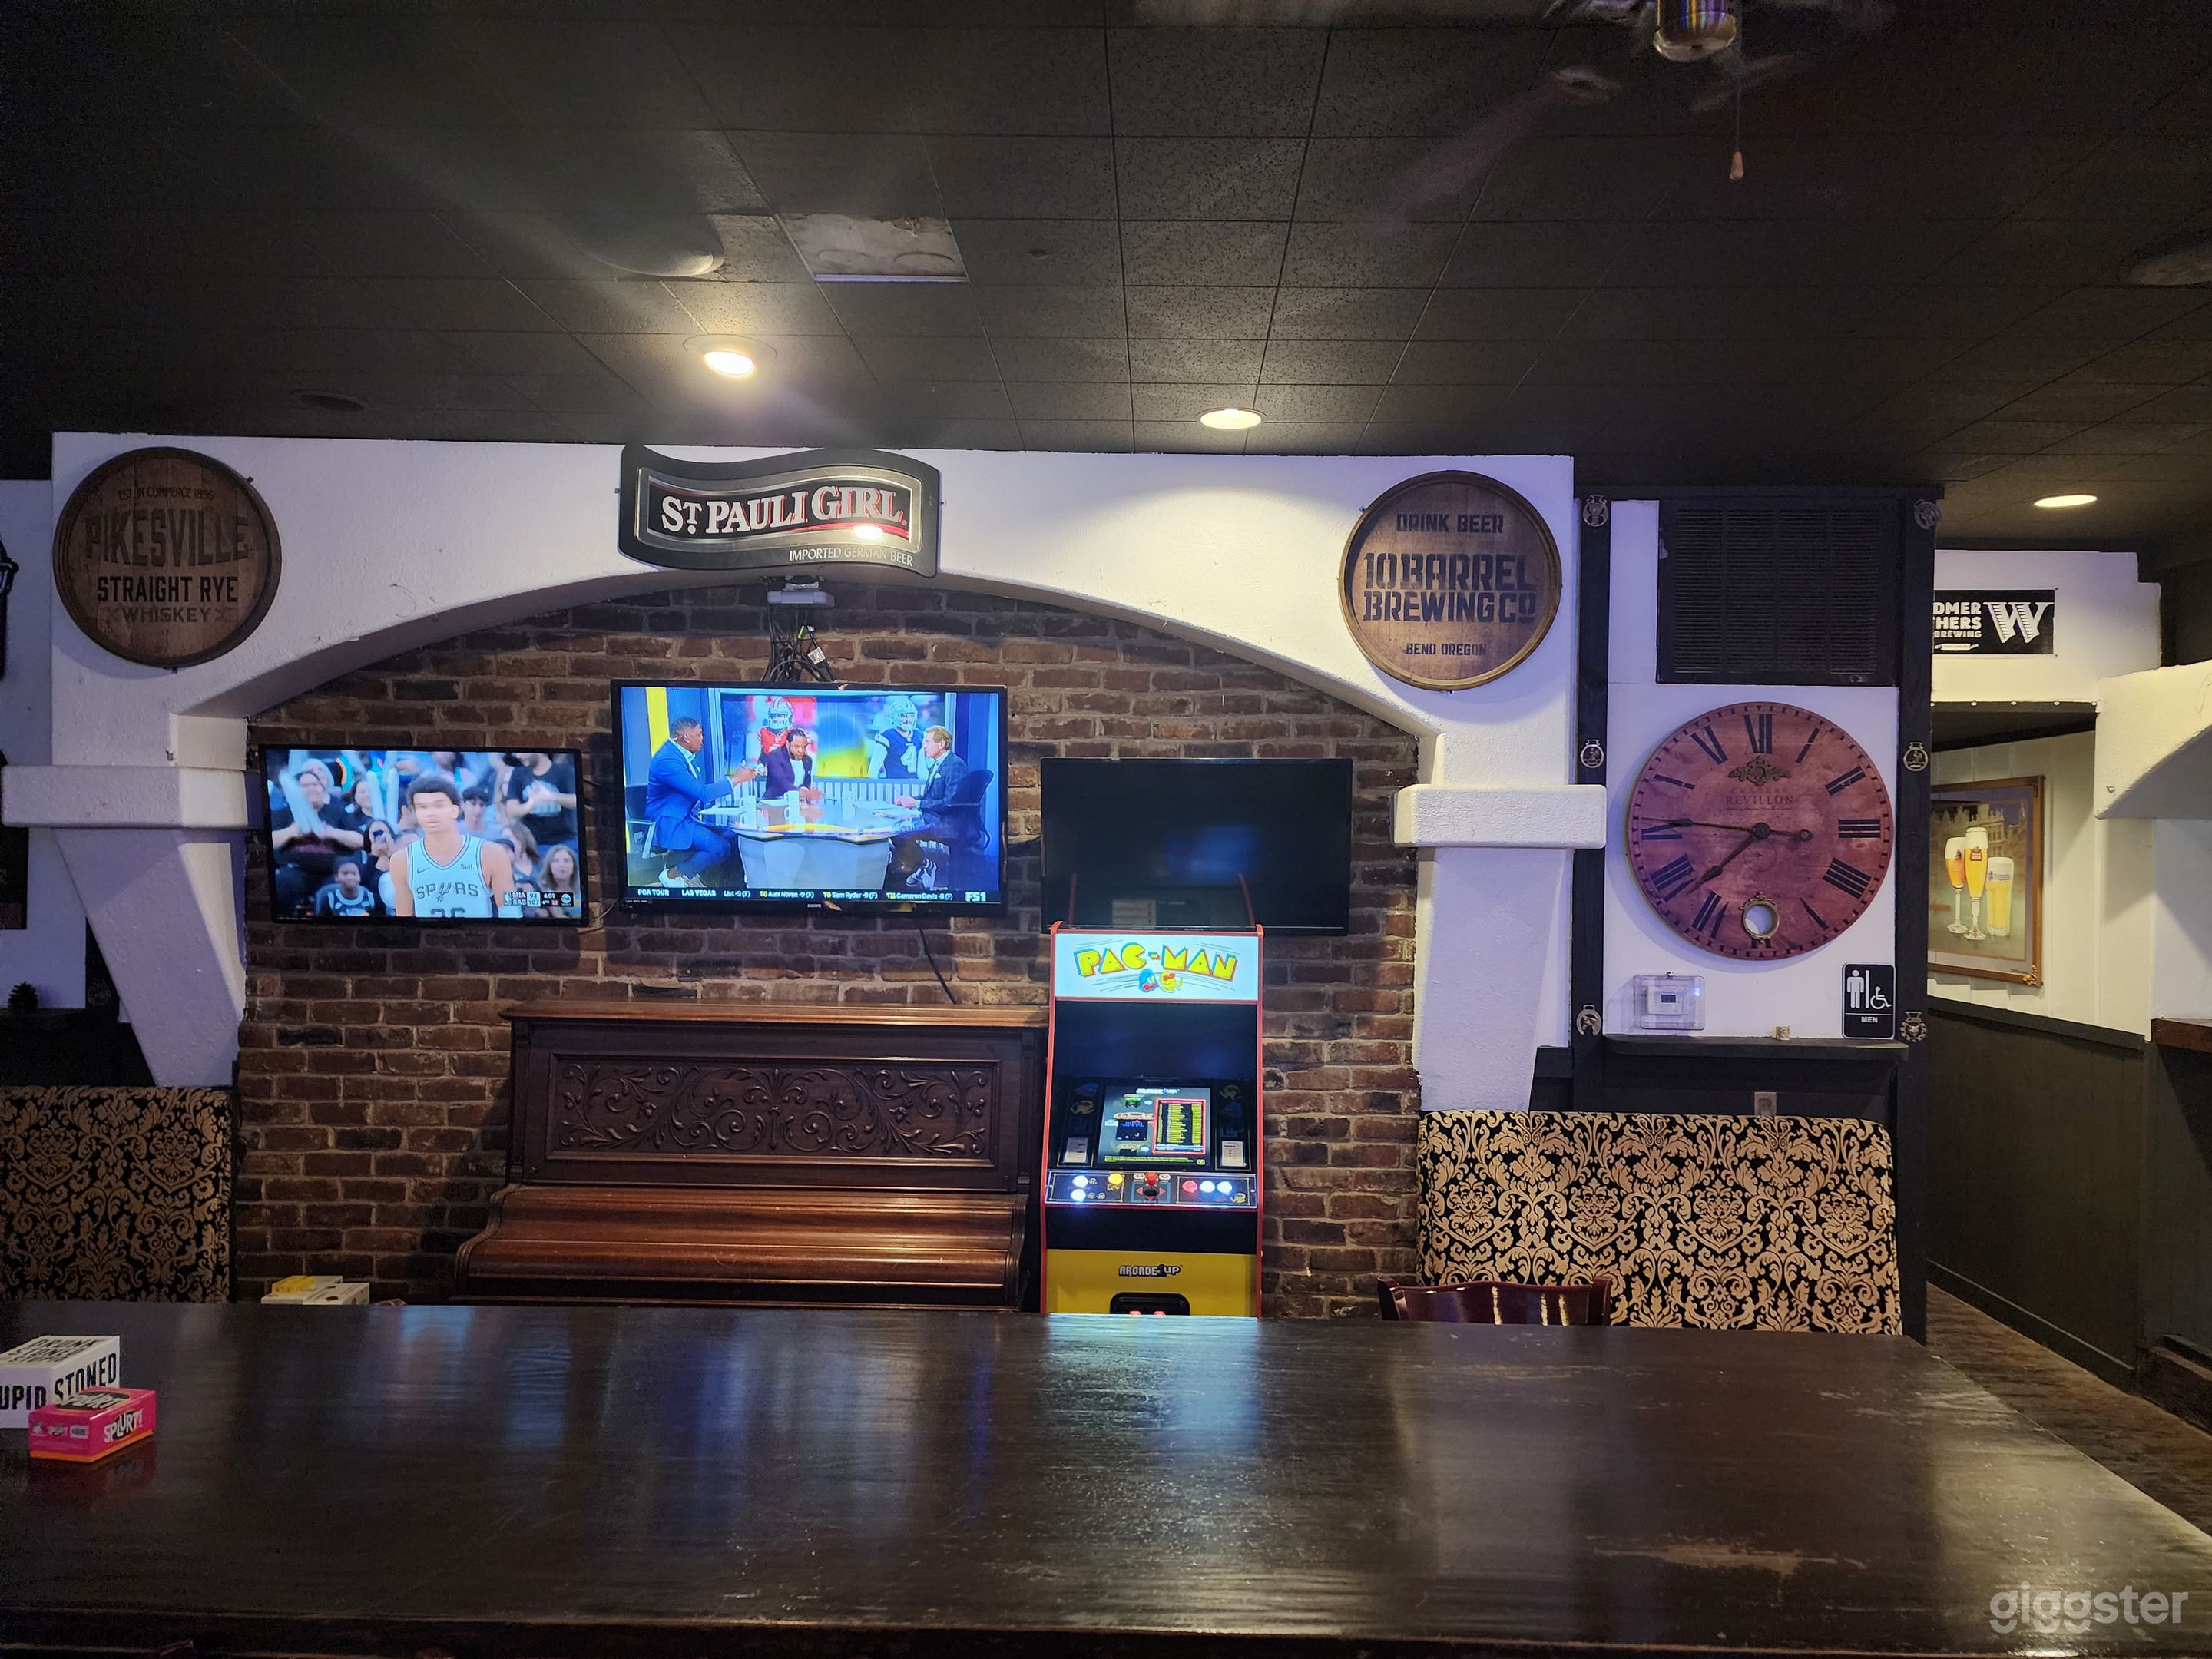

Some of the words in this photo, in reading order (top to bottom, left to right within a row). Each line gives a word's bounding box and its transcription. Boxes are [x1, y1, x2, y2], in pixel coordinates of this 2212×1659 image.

[705, 491, 808, 534] PAULI
[1396, 513, 1450, 533] DRINK
[1457, 514, 1505, 534] BEER
[84, 507, 250, 568] PIKESVILLE
[789, 547, 842, 561] IMPORTED
[844, 547, 887, 560] GERMAN
[890, 551, 913, 567] BEER
[97, 576, 193, 602] STRAIGHT
[200, 576, 239, 602] RYE
[121, 607, 211, 623] WHISKEY
[1932, 616, 1982, 630] HERS
[1074, 942, 1238, 982] PAC-MAN
[55, 1353, 117, 1401] STONED
